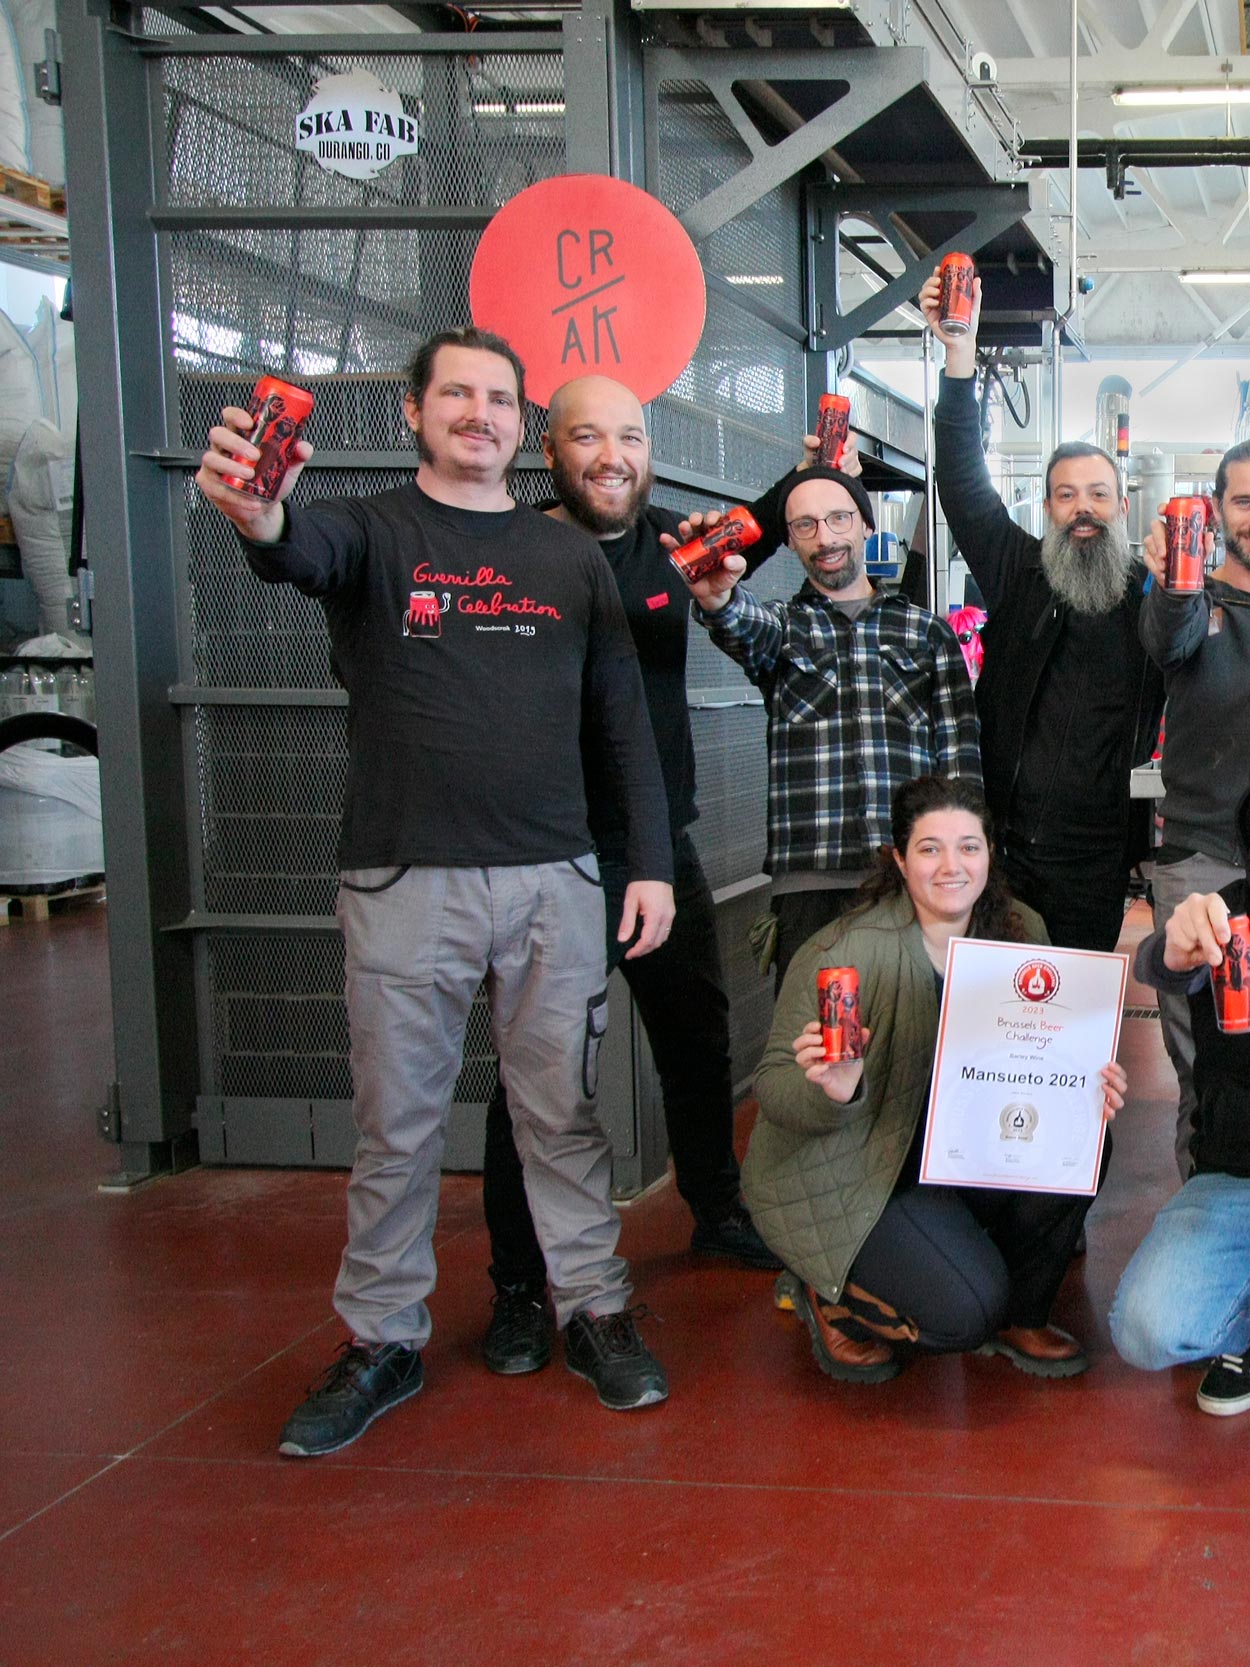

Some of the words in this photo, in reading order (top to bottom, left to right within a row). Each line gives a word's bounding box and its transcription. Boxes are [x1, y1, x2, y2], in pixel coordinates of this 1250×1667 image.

[299, 109, 353, 140] SKA
[364, 109, 415, 143] FAB
[376, 142, 390, 160] CO
[413, 562, 512, 587] Guerrilla
[456, 592, 562, 620] Celebration
[1022, 1006, 1044, 1015] 2023
[997, 1016, 1036, 1030] Brussels
[1040, 1020, 1064, 1032] Beer
[1005, 1030, 1053, 1050] Challenge
[961, 1066, 1044, 1086] Mansueto
[1048, 1073, 1087, 1089] 2021
